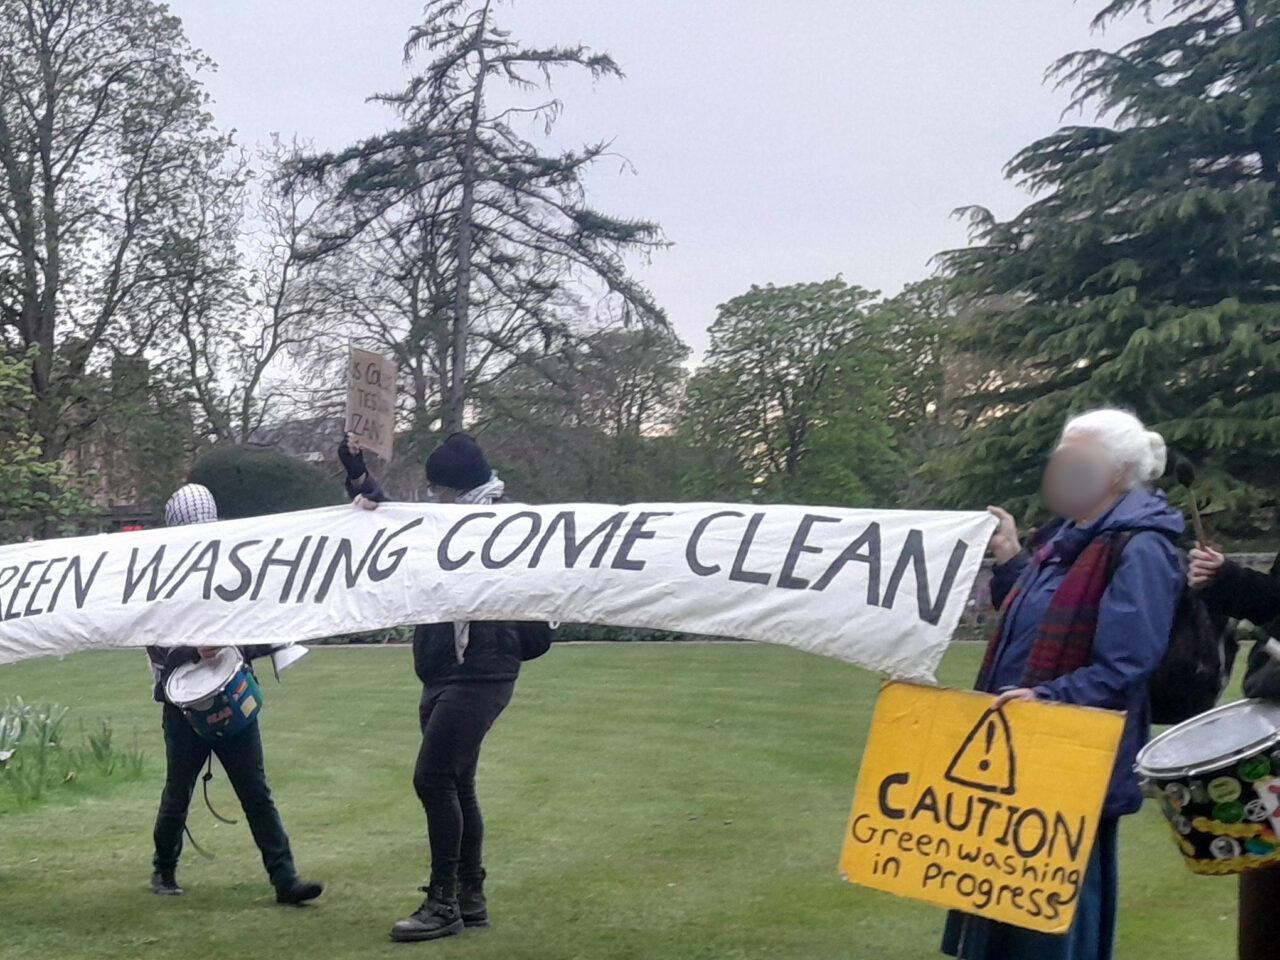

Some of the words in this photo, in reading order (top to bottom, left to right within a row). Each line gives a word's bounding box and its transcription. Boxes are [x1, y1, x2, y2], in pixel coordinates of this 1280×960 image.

[122, 517, 424, 604] WASHING
[436, 511, 674, 571] COME
[684, 511, 969, 625] CLEAN
[877, 772, 1086, 862] CAUTION
[872, 853, 900, 877] in
